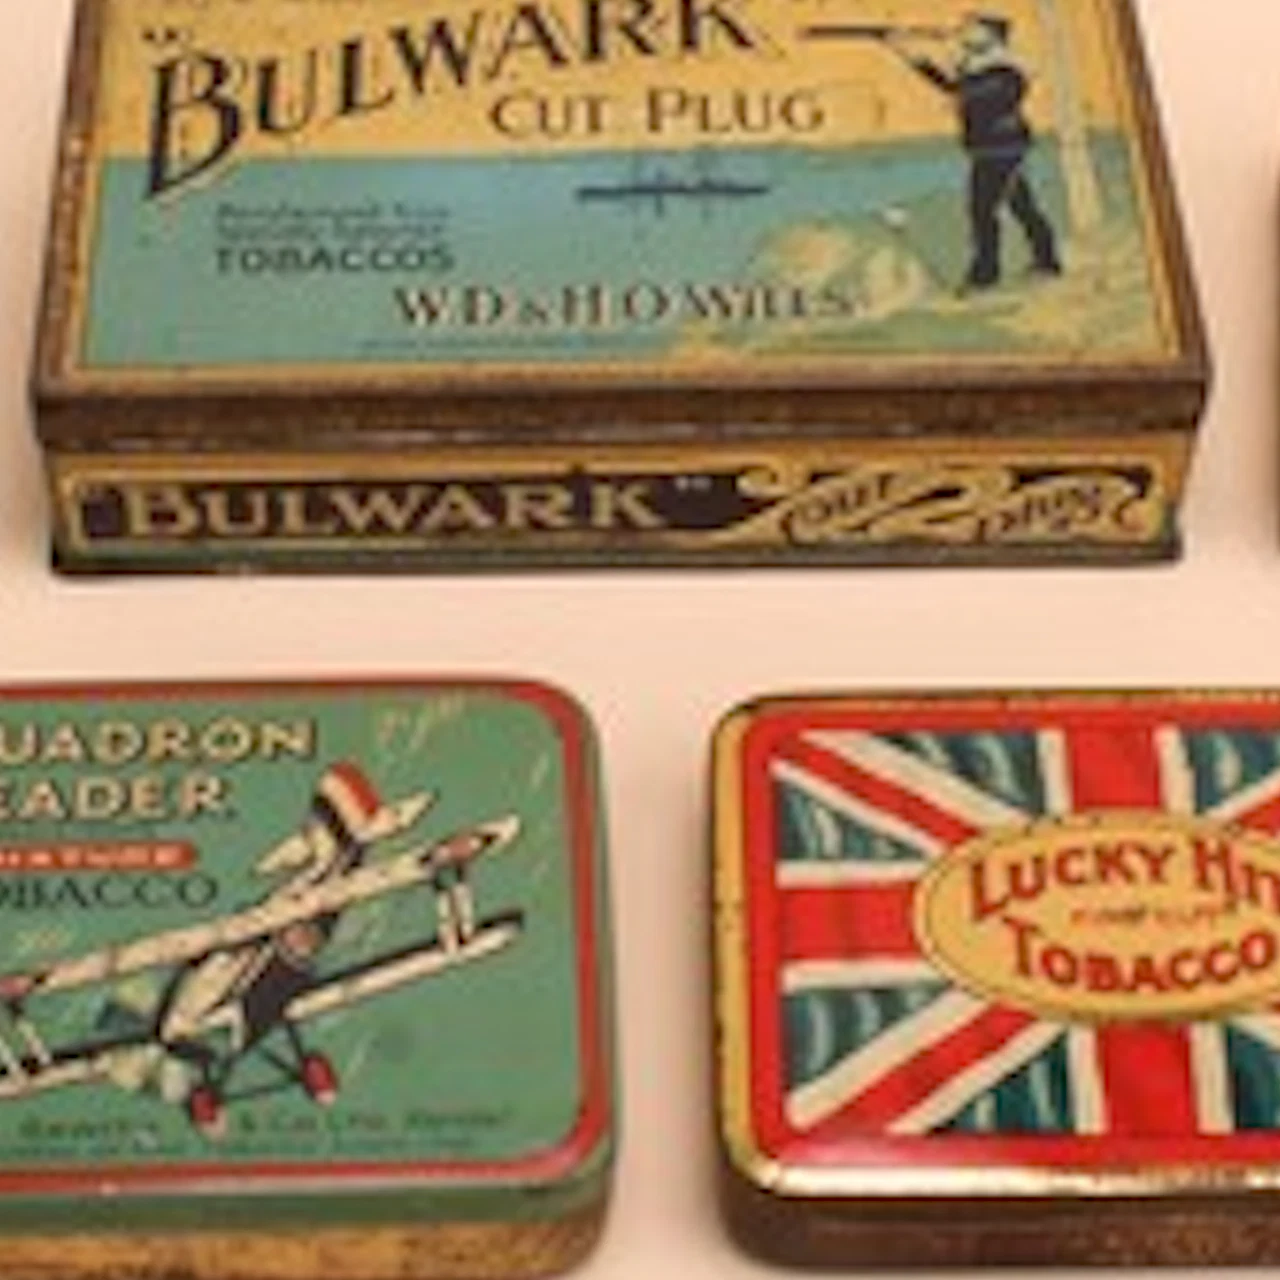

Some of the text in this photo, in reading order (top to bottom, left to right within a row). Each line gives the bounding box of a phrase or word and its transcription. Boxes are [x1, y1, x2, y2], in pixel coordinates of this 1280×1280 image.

[487, 86, 827, 141] CUT PLUG
[215, 245, 456, 276] TOBACCOS
[971, 837, 1176, 922] LUCKY
[1003, 915, 1278, 993] TOBACCO
